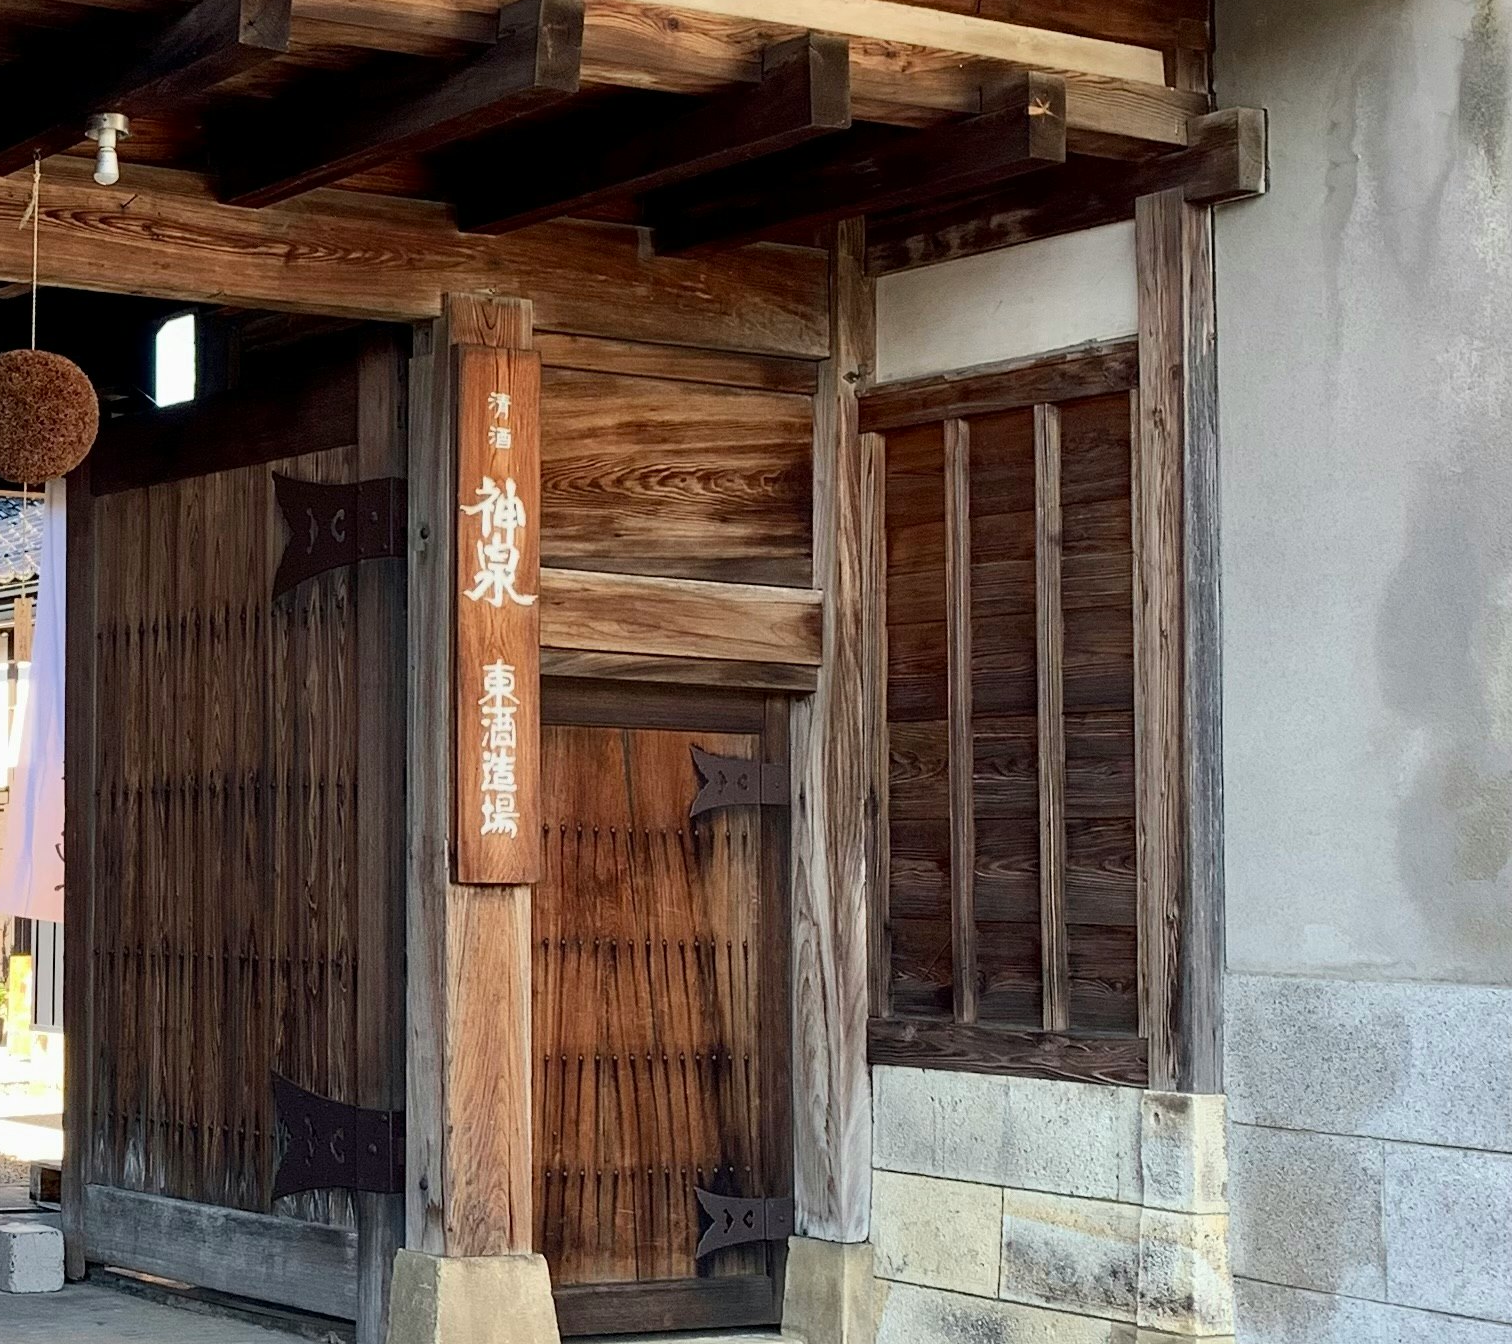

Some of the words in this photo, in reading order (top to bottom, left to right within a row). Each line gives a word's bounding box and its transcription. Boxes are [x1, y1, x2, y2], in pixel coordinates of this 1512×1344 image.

[487, 391, 513, 450] 清酒
[459, 476, 539, 608] 神泉
[477, 658, 520, 840] 東酒造場
